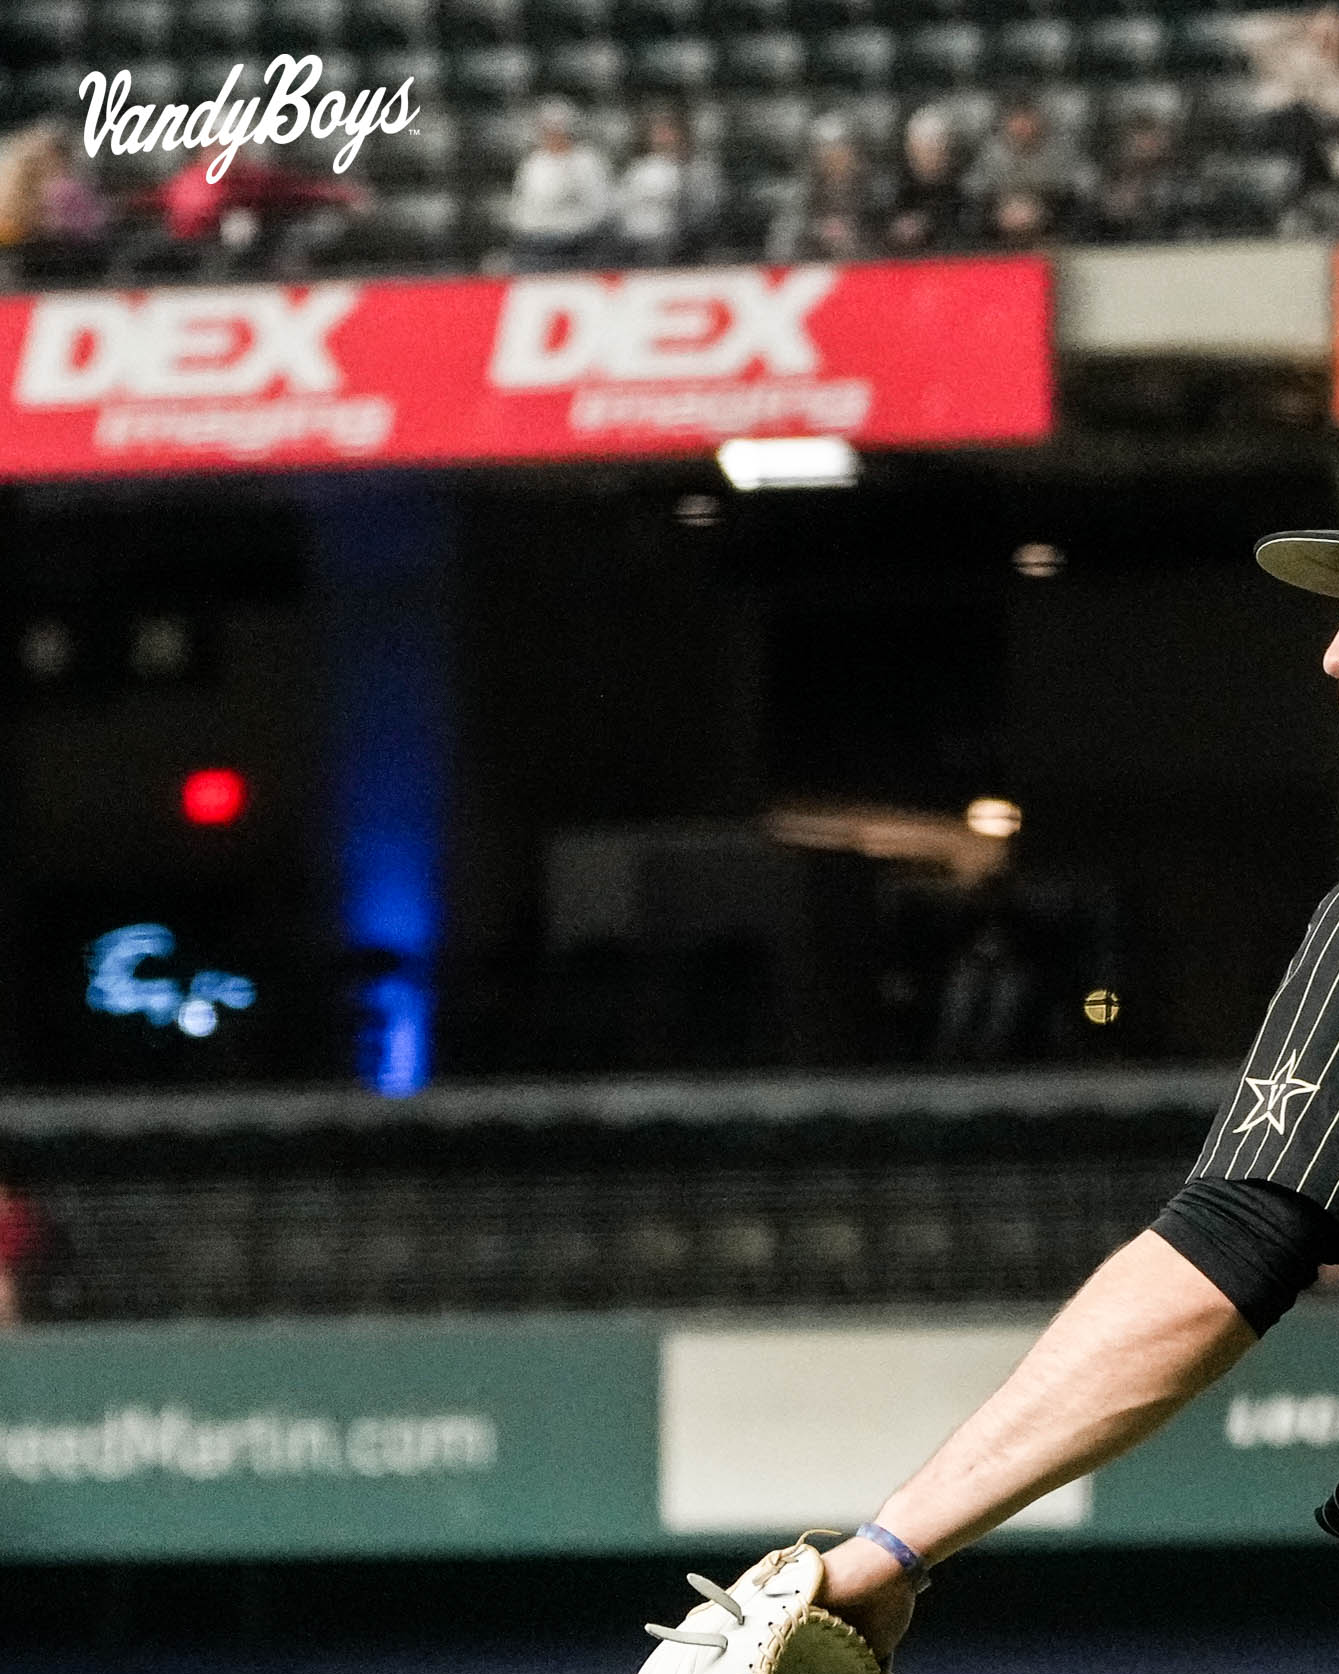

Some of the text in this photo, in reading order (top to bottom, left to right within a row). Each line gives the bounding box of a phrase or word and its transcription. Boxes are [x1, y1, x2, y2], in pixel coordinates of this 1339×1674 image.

[14, 284, 363, 405] DEX
[487, 268, 842, 387] DEX
[0, 1400, 499, 1482] eedMartin.com
